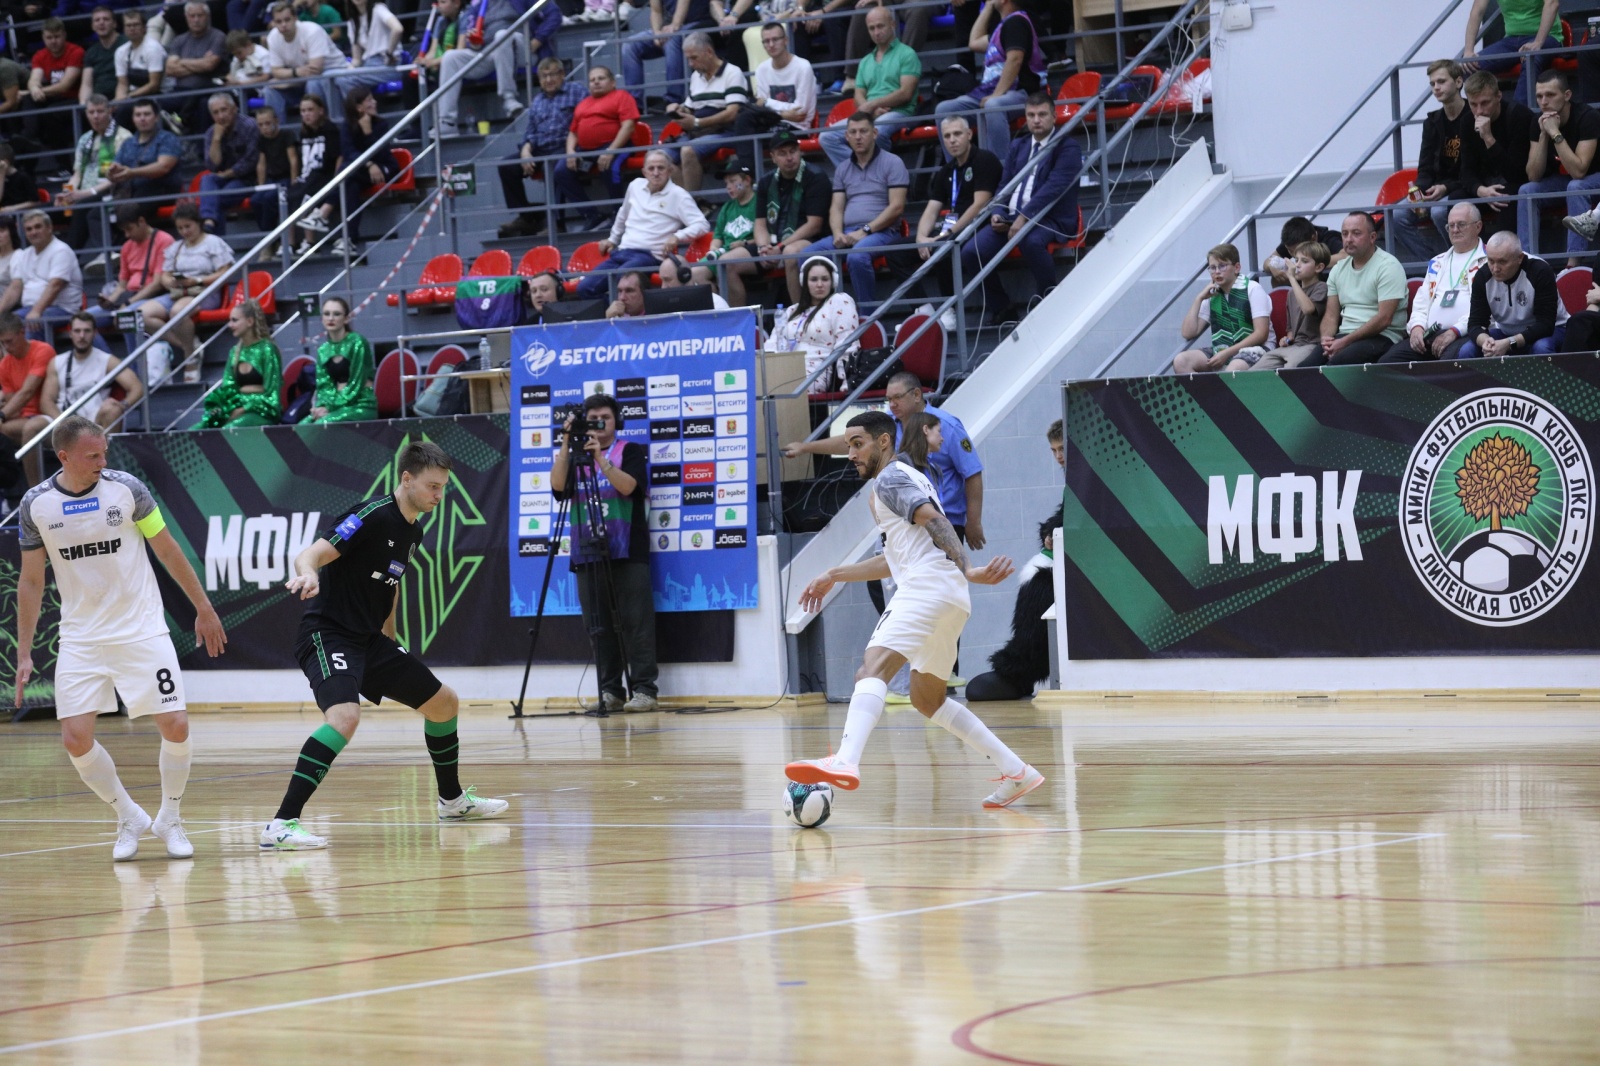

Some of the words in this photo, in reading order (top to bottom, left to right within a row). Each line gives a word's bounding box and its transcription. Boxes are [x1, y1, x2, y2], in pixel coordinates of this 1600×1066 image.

[559, 343, 646, 366] БЕТСИТИ
[647, 335, 745, 359] СУПЕРЛИГА
[683, 379, 712, 387] БЕТСИТИ
[650, 404, 679, 412] БЕТСИТИ
[717, 399, 746, 407] БЕТСИТИ
[522, 412, 549, 420] БЕТСИТИ
[617, 429, 647, 437] БЕТСИТИ
[683, 424, 714, 435] JÖGEL
[1542, 418, 1580, 469] КЛУБ
[1570, 477, 1587, 520] ЛКС
[685, 472, 713, 480] СПОРТ
[651, 493, 679, 501] БЕТСИТИ
[64, 501, 97, 511] БЕТСИТИ
[683, 514, 713, 522] БЕТСИТИ
[1207, 470, 1363, 564] МФК
[48, 522, 64, 531] JAKO
[716, 534, 746, 544] JÖGEL
[58, 538, 122, 560] СИБУР
[205, 512, 321, 591] МФК
[519, 543, 548, 553] JÖGEL
[1420, 552, 1500, 616] ЛИПЕЦКАЯ
[1509, 550, 1577, 614] ОБЛАСТЬ
[332, 652, 348, 670] 5
[156, 668, 175, 695] 8
[161, 695, 178, 704] JAKO
